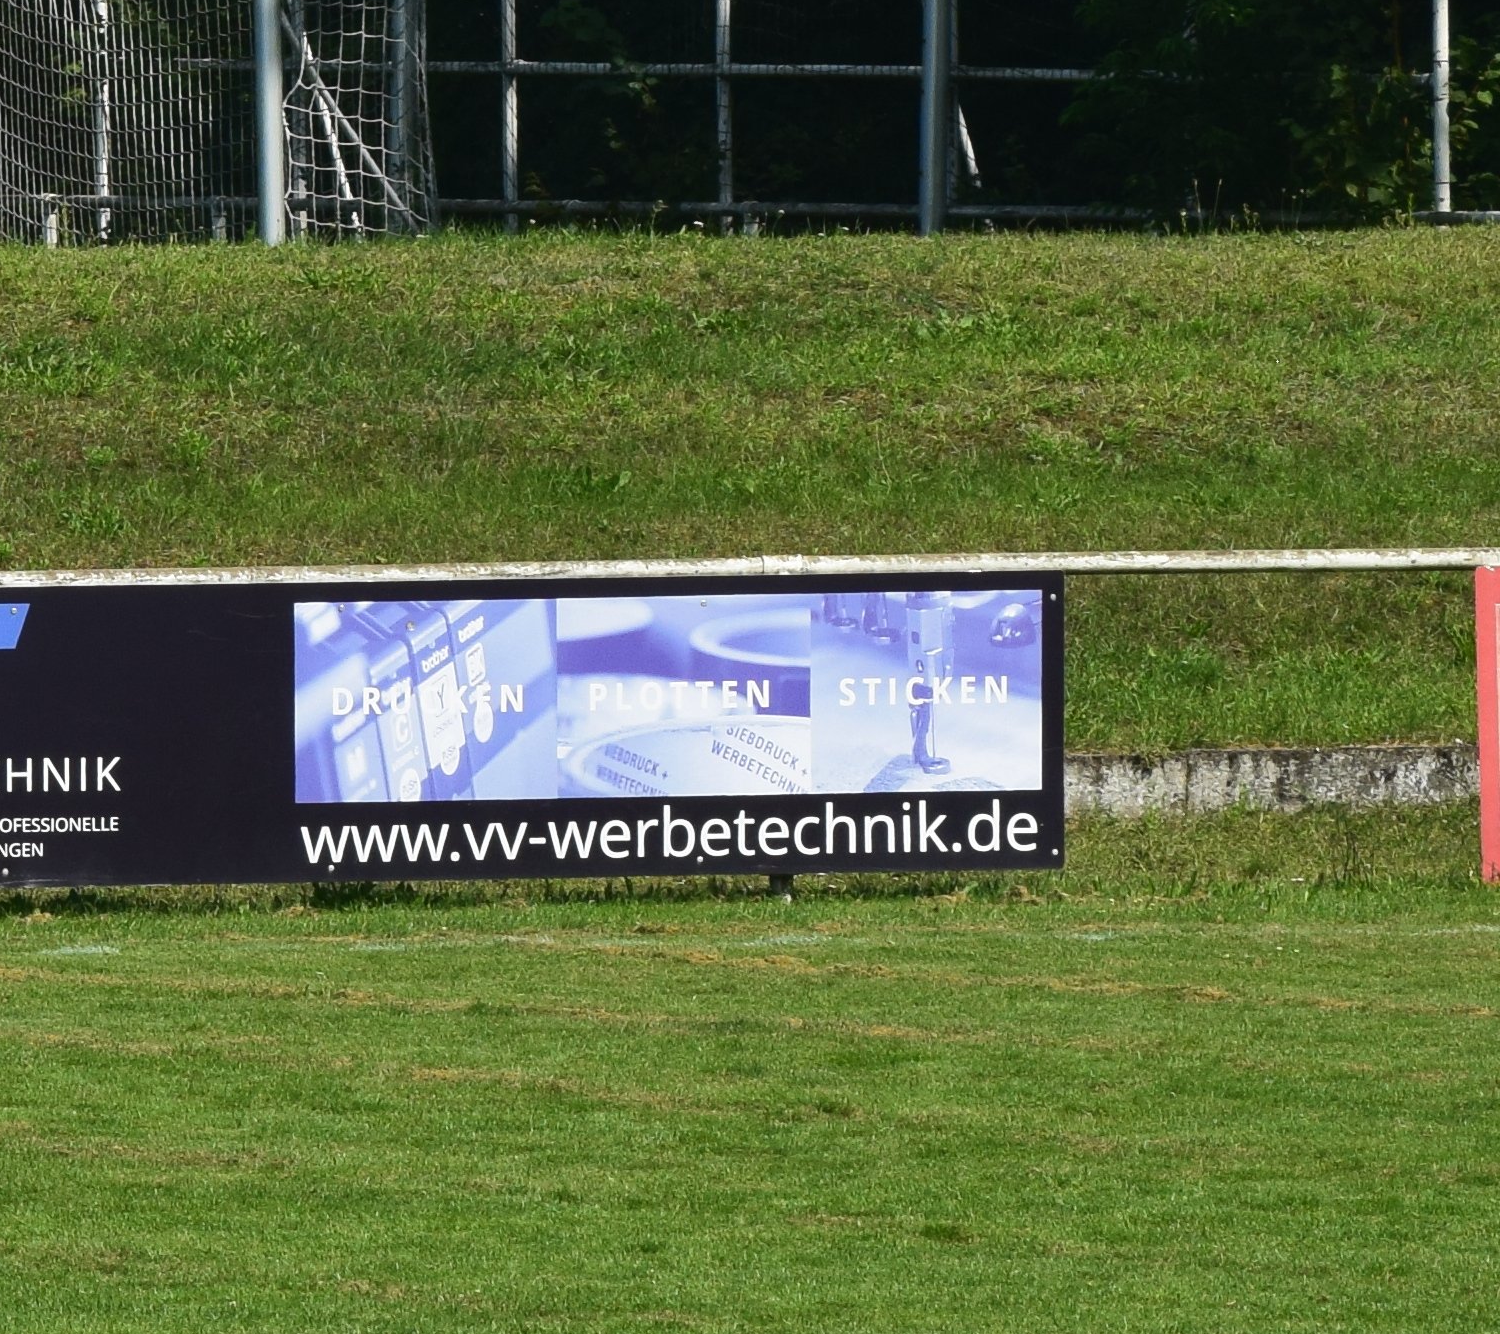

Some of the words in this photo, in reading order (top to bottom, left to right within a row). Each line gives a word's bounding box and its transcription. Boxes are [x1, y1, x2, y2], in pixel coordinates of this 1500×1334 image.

[589, 679, 770, 711] PLOTTEN
[839, 675, 1008, 706] STICKEN
[300, 799, 1040, 864] www.vv-werbetechnik.de
